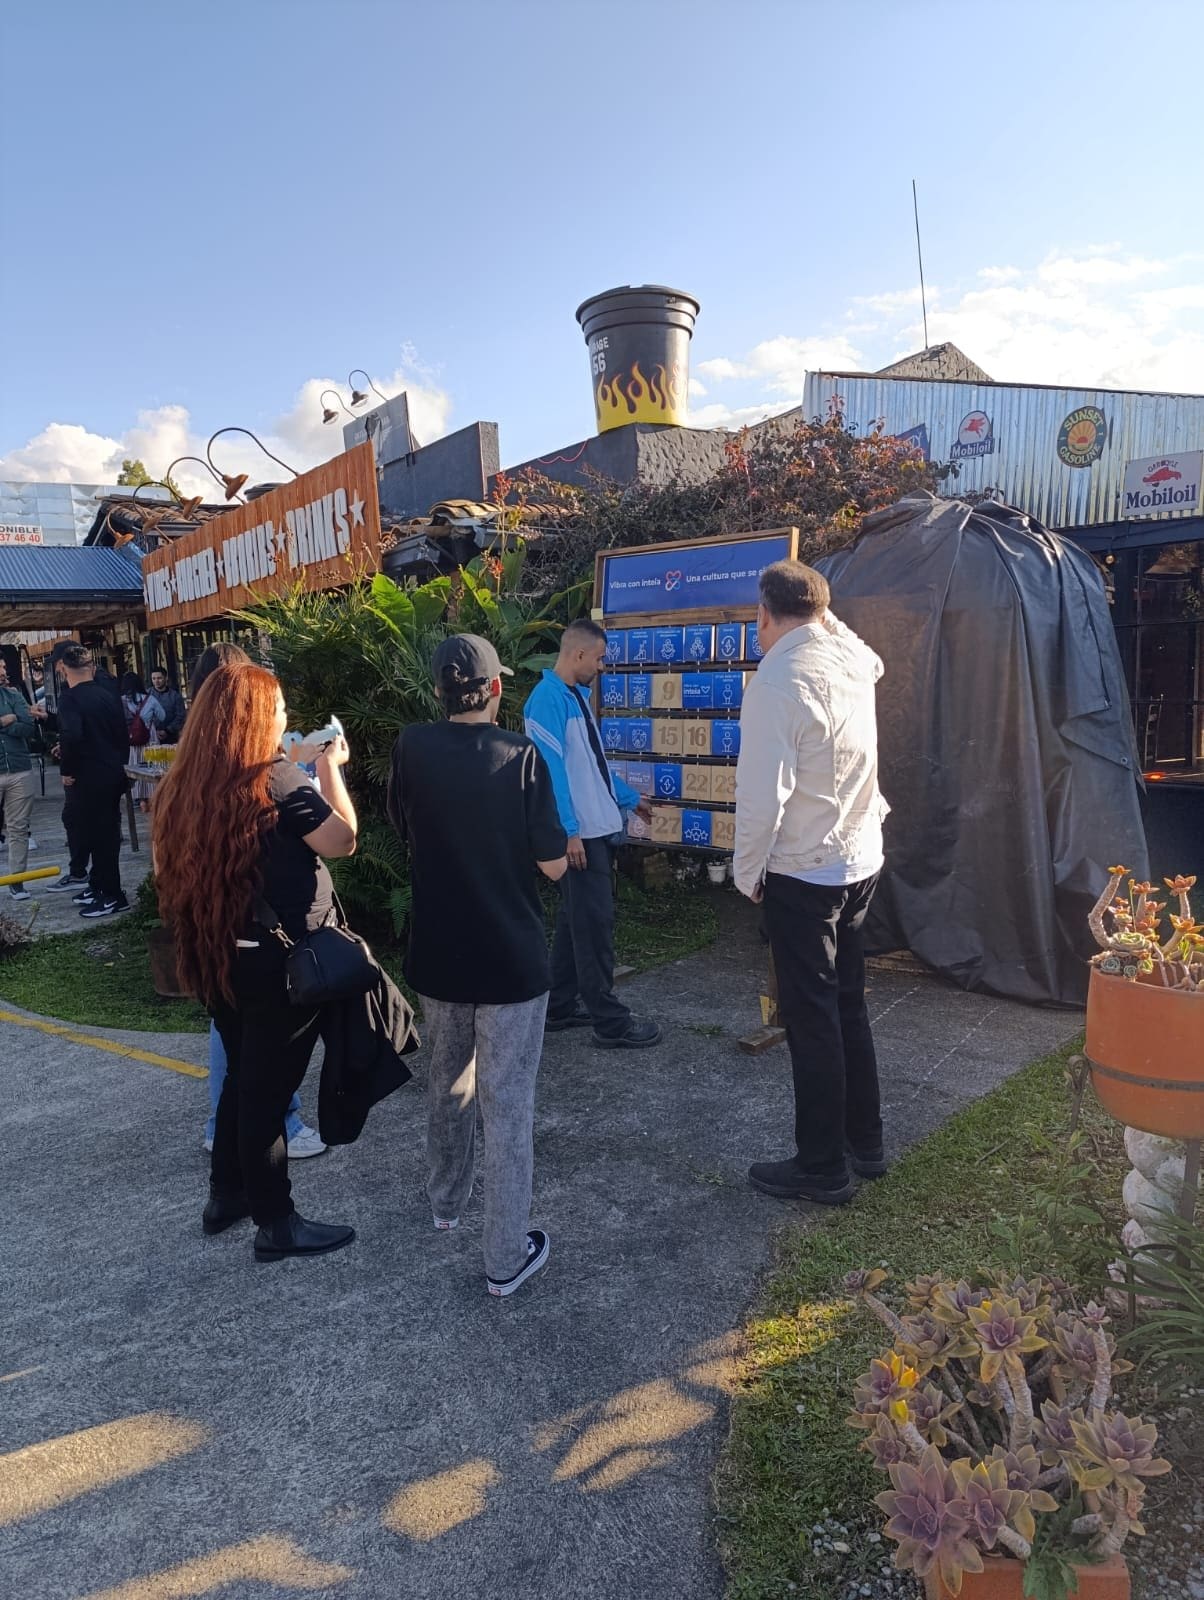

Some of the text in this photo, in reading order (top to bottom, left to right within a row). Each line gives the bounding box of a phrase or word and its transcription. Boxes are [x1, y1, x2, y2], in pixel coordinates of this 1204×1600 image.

[593, 352, 606, 373] 56
[1064, 407, 1104, 430] SUNSET
[952, 439, 992, 458] Mobiloil
[1059, 445, 1101, 467] GASOLINE
[1126, 484, 1196, 509] Mobiloil
[15, 533, 26, 542] 46
[29, 534, 40, 543] 40
[286, 488, 351, 568] DRINKS
[609, 581, 626, 589] Vibra
[702, 572, 729, 581] cultura
[731, 571, 746, 580] que
[663, 680, 675, 700] 9
[658, 726, 707, 747] 15 16
[686, 774, 708, 793] 22
[655, 816, 680, 835] 27
